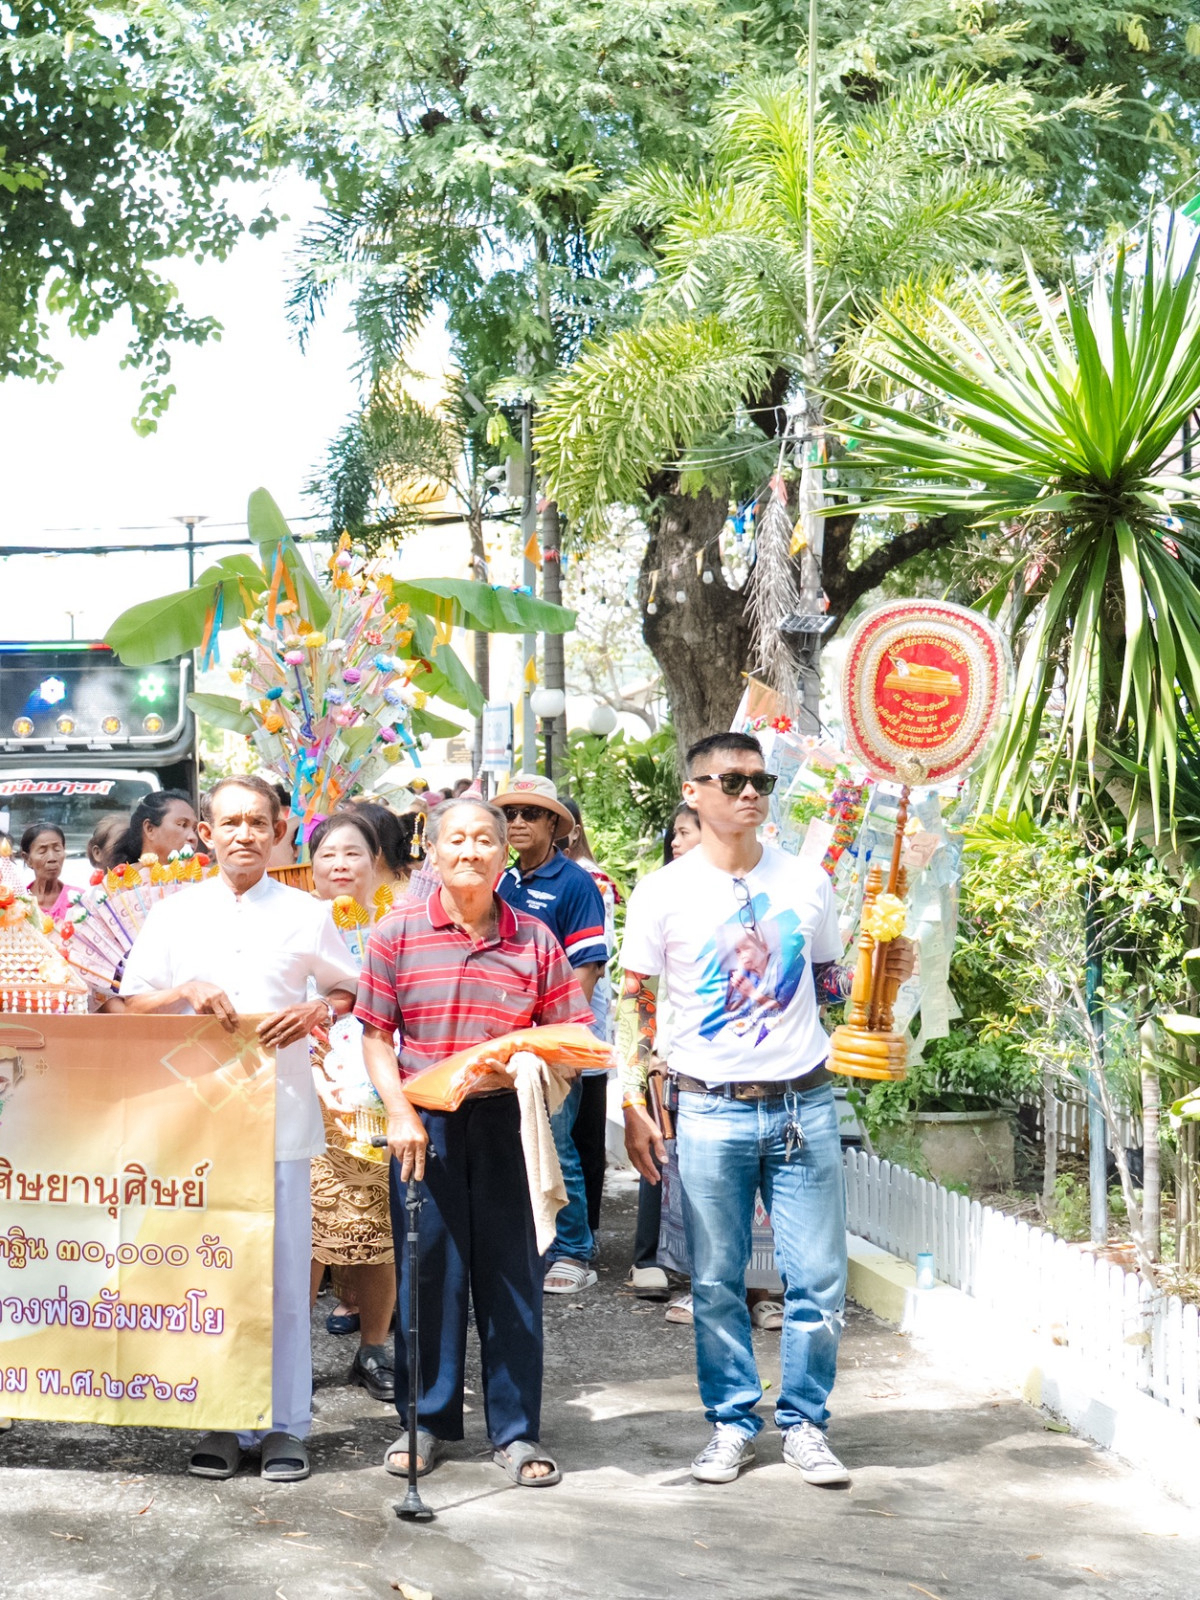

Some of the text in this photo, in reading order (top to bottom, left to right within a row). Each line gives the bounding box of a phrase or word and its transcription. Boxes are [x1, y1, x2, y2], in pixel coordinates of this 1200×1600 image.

[57, 1241, 189, 1269] ๓๐,๐๐๐
[197, 1239, 234, 1270] วัด
[37, 1367, 199, 1403] พ.ศ.๒๕๖๘
